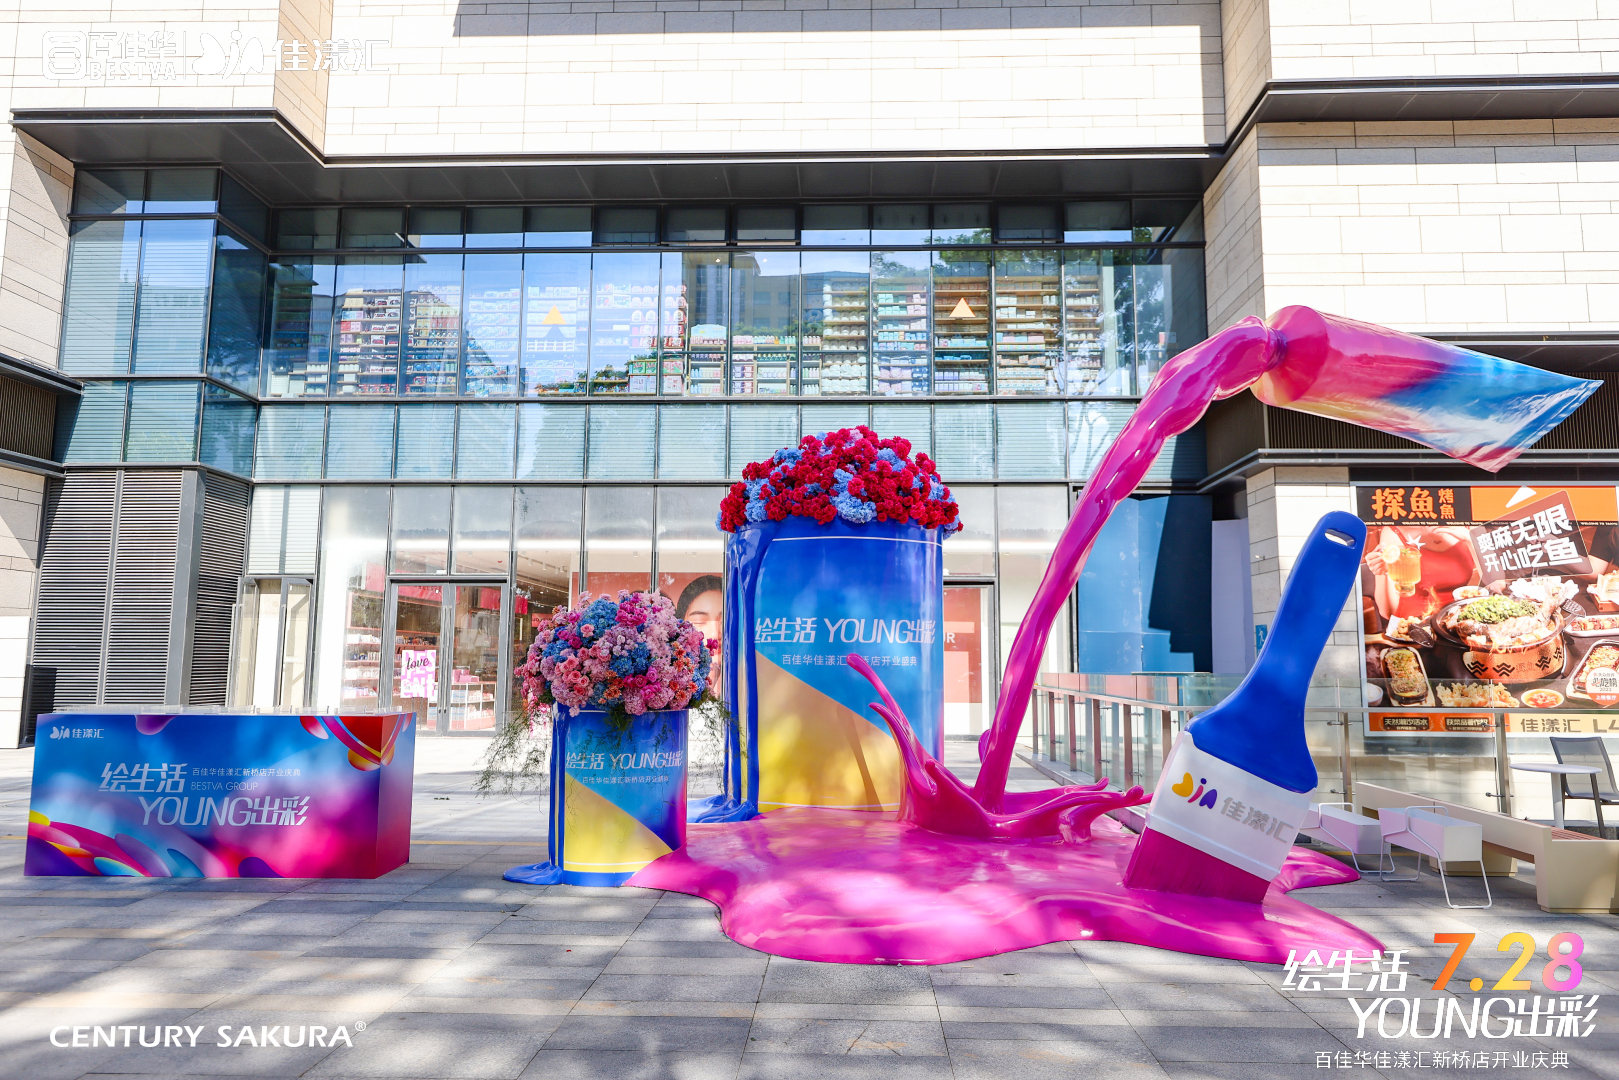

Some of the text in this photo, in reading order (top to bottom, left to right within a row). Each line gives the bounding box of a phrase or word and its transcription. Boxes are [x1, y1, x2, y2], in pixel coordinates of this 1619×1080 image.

[1371, 486, 1438, 520] 探魚
[1476, 503, 1573, 554] 爽麻无限
[1482, 536, 1583, 573] 开心吃鱼
[754, 617, 936, 644] 绘生活 YOUNG出彩
[72, 728, 105, 738] 佳漾汇
[1520, 718, 1582, 733] 佳漾汇
[565, 752, 605, 770] 绘生活
[99, 763, 188, 793] 绘生活
[191, 781, 259, 791] BESTVA GROUP
[138, 796, 310, 827] YOUNG出彩
[1220, 797, 1294, 844] 佳漾汇
